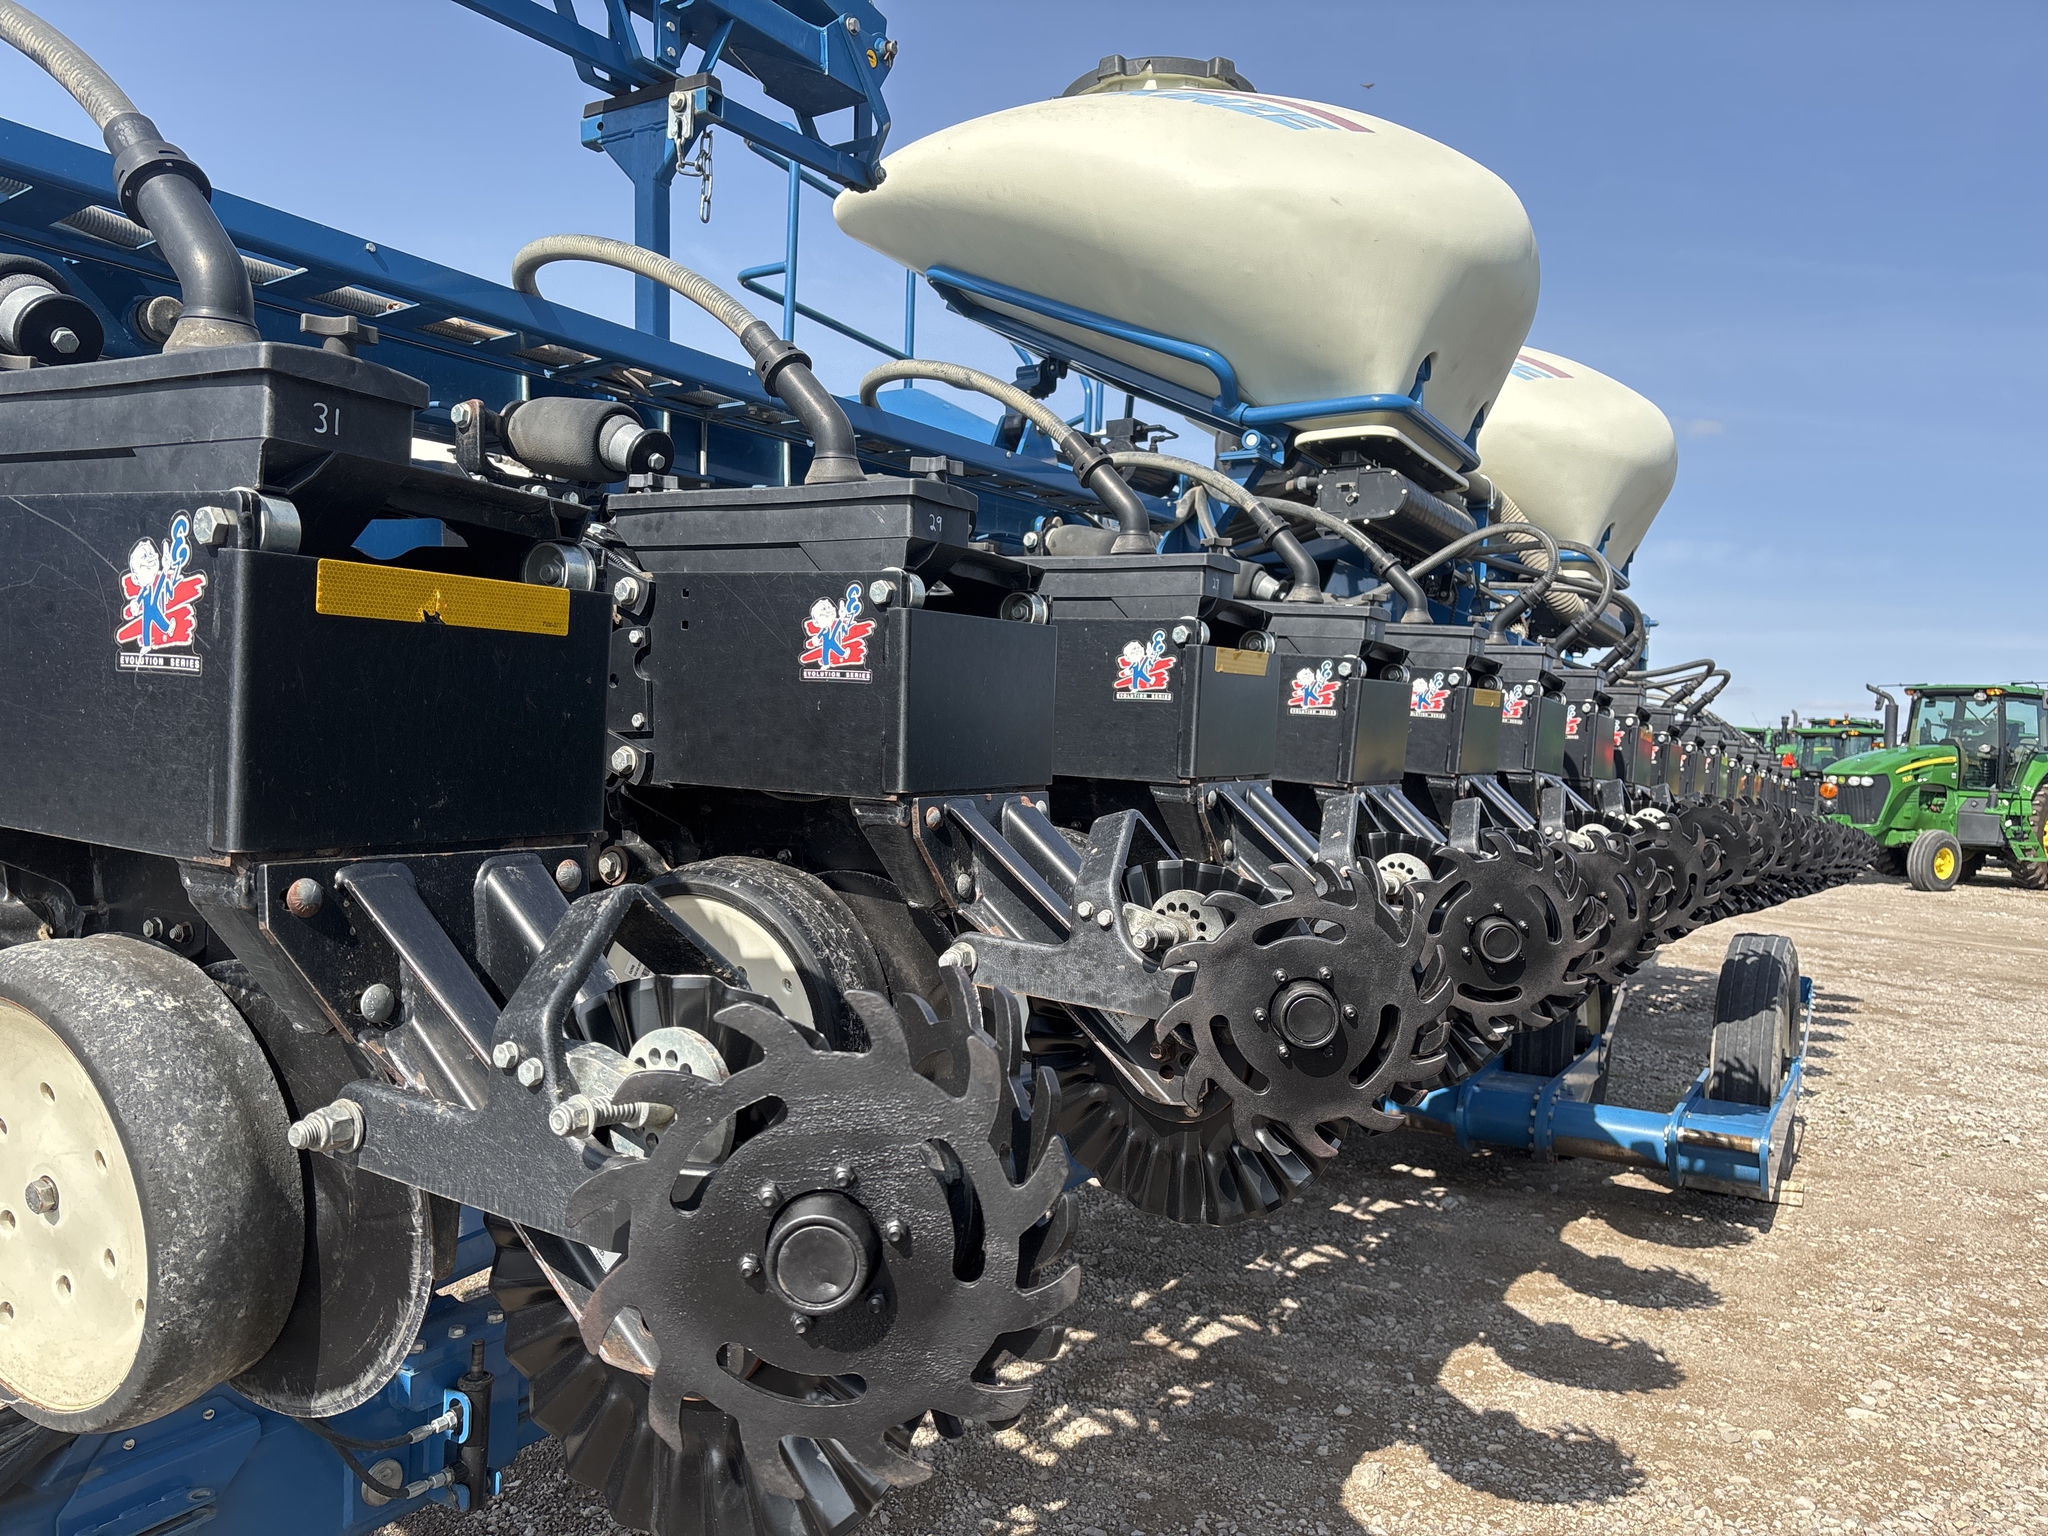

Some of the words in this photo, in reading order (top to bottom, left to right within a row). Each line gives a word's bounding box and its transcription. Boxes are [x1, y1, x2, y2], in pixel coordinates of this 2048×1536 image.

[313, 402, 340, 436] 31
[928, 513, 943, 532] 29
[119, 655, 164, 666] EVOLUTION
[170, 657, 200, 669] SERIES
[845, 671, 870, 679] SERIES
